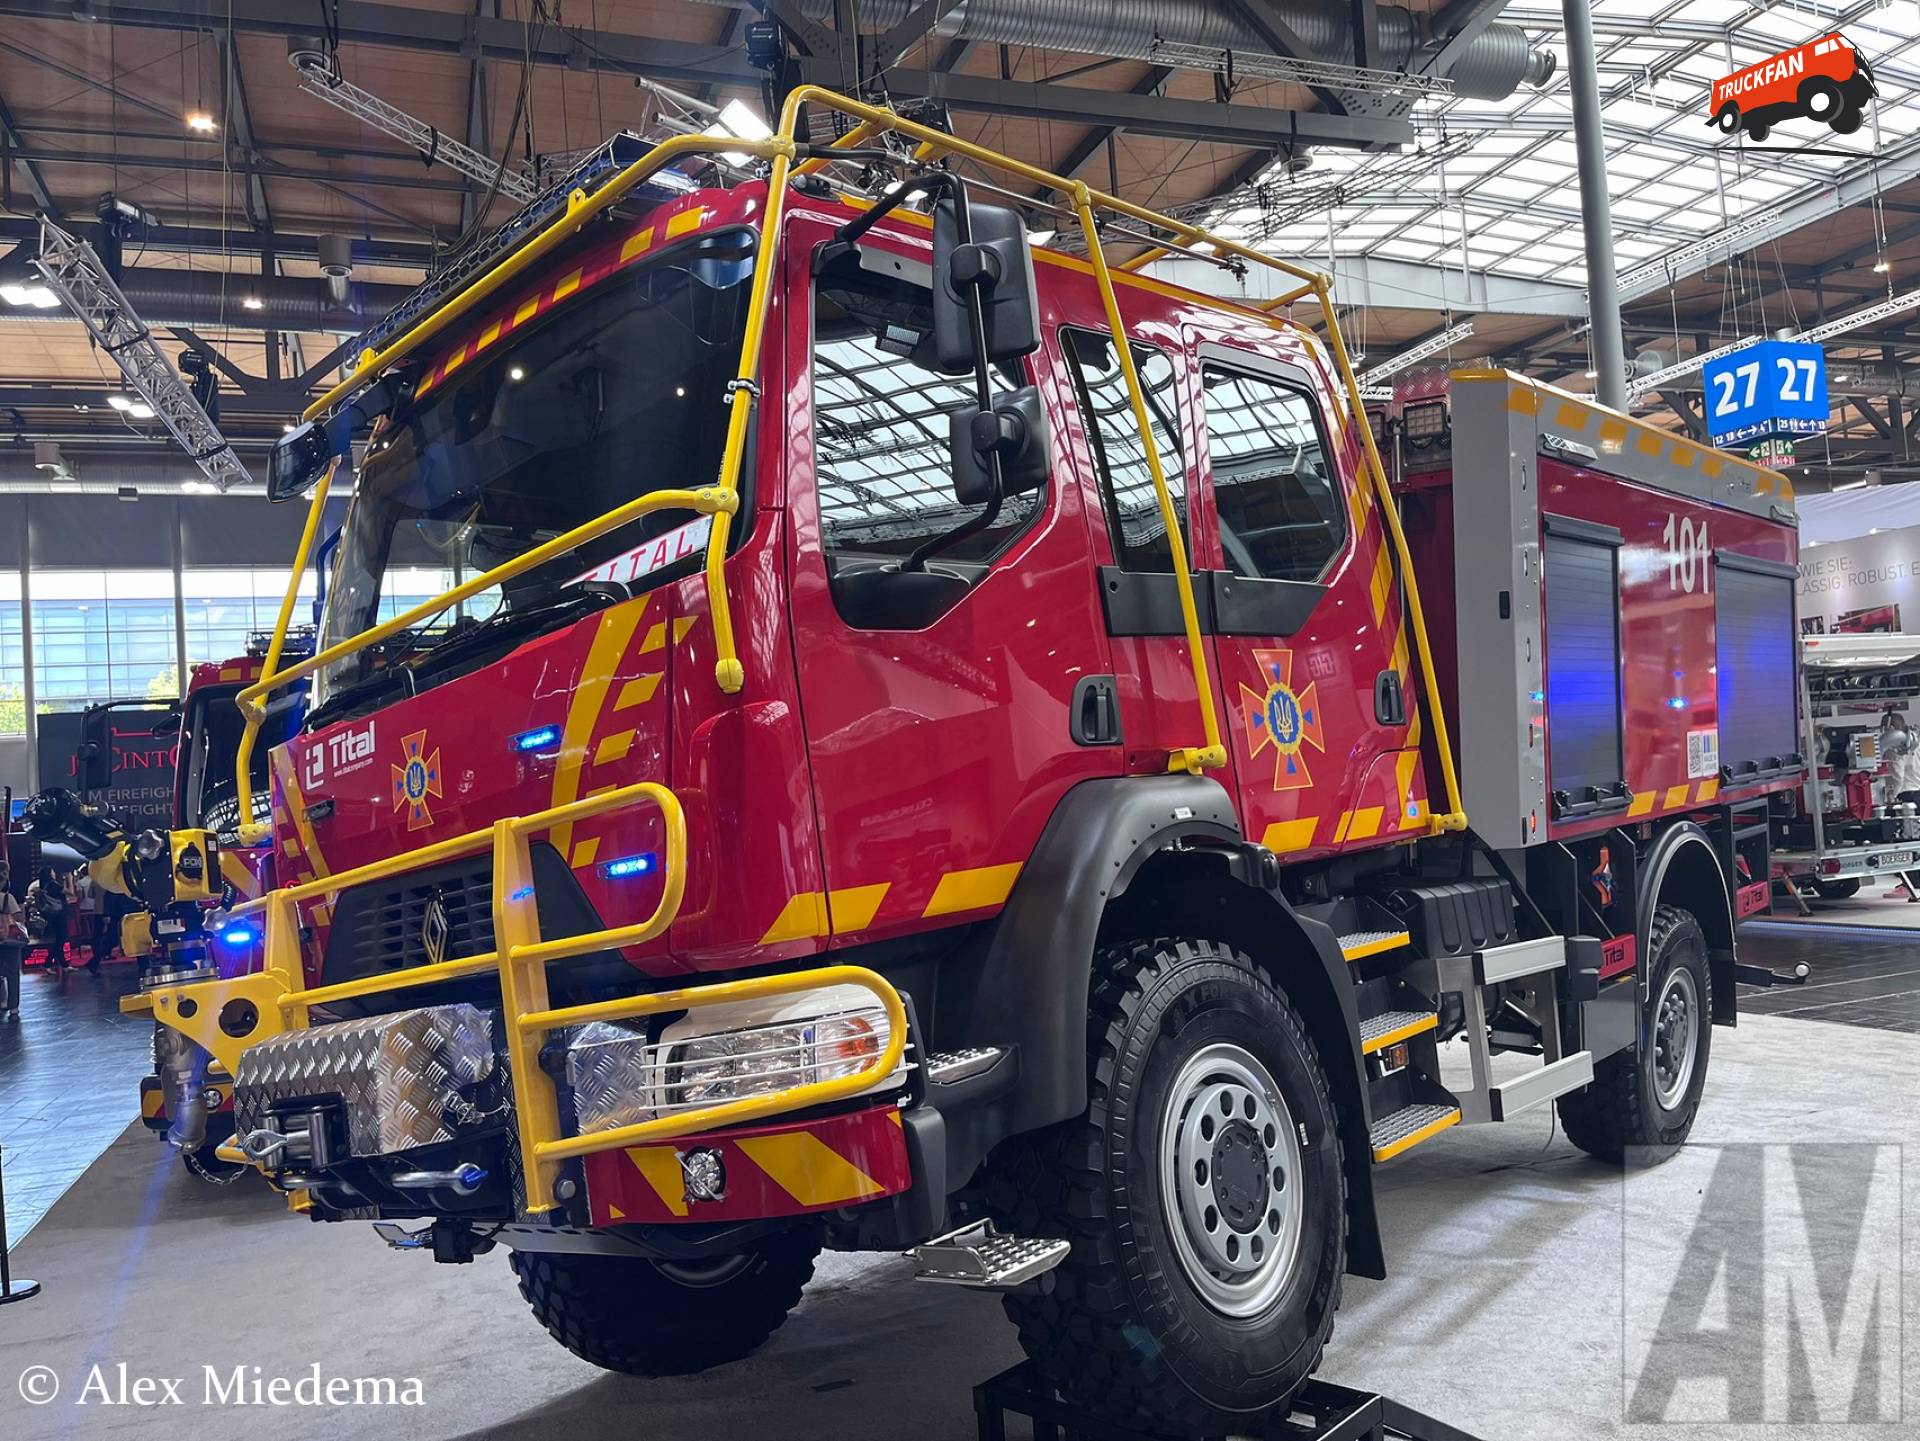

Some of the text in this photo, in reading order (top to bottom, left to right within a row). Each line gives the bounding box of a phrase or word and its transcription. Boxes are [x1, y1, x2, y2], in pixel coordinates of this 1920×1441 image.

[1712, 361, 1760, 418] 27
[1776, 357, 1817, 402] 27
[1663, 512, 1709, 594] 101
[1799, 560, 1825, 577] WIE
[328, 719, 376, 769] Tital
[1603, 943, 1625, 967] Tital
